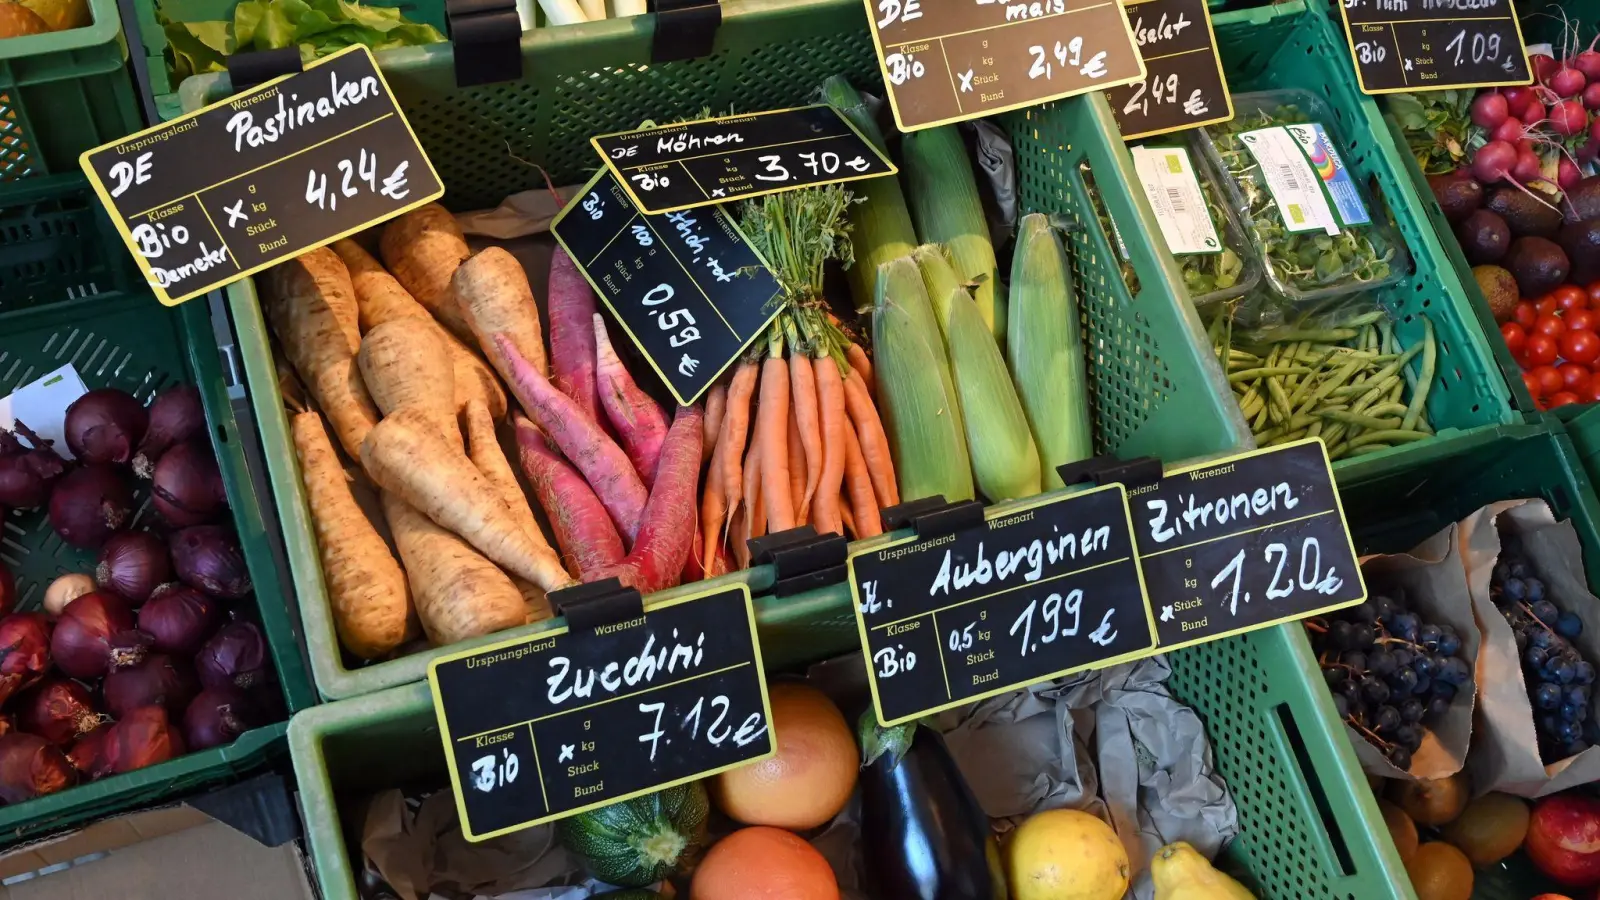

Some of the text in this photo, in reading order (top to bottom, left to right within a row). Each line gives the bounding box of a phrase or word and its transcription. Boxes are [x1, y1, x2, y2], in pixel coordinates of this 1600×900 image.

[1361, 24, 1384, 33] Klasse
[900, 43, 930, 55] Klasse
[982, 39, 989, 48] g
[1355, 40, 1387, 64] Bio
[1421, 43, 1430, 51] kg
[885, 53, 925, 85] Bio
[982, 56, 994, 66] kg
[973, 73, 1000, 85] Stück
[1420, 72, 1438, 80] Bund
[230, 86, 280, 112] Warenart
[980, 90, 1005, 103] Bund
[715, 116, 757, 126] Warenart
[109, 71, 379, 198] DE Pastinaken
[116, 117, 199, 155] Ursprungsland
[619, 126, 688, 141] Ursprungsland
[611, 132, 744, 159] DE Möhren
[637, 163, 669, 173] Klasse
[248, 184, 256, 194] g
[631, 172, 670, 191] Bio
[728, 184, 754, 193] Bund
[582, 191, 605, 220] Bio
[609, 185, 629, 209] Klasse
[148, 203, 185, 223] Klasse
[251, 201, 267, 213] kg
[246, 217, 278, 237] Stück
[712, 208, 741, 244] Warenart
[132, 223, 190, 259] Bio
[259, 235, 288, 253] Bund
[631, 225, 657, 256] 100 g
[149, 242, 229, 289] Demeter
[614, 260, 633, 282] Stück
[634, 257, 645, 270] kg
[706, 256, 737, 282] rot
[603, 274, 621, 295] Bund
[1189, 463, 1235, 482] Warenart
[987, 511, 1035, 531] Warenart
[1146, 482, 1299, 543] Zitronen
[878, 533, 956, 561] Ursprungsland
[929, 525, 1110, 597] Auberginen
[1185, 557, 1192, 569] g
[1185, 577, 1197, 588] kg
[1174, 597, 1203, 612] Stück
[980, 609, 987, 620] g
[594, 615, 648, 637] Warenart
[886, 620, 921, 637] Klasse
[1181, 617, 1208, 632] Bund
[978, 629, 991, 641] kg
[466, 637, 557, 670] Ursprungsland
[873, 644, 917, 678] Bio
[966, 649, 995, 666] Stück
[546, 628, 706, 705] Zucchini
[972, 669, 1000, 685] Bund
[583, 718, 592, 730] g
[475, 729, 515, 748] Klasse
[581, 738, 596, 754] kg
[471, 748, 520, 793] Bio
[567, 760, 600, 778] Stück
[573, 781, 604, 798] Bund
